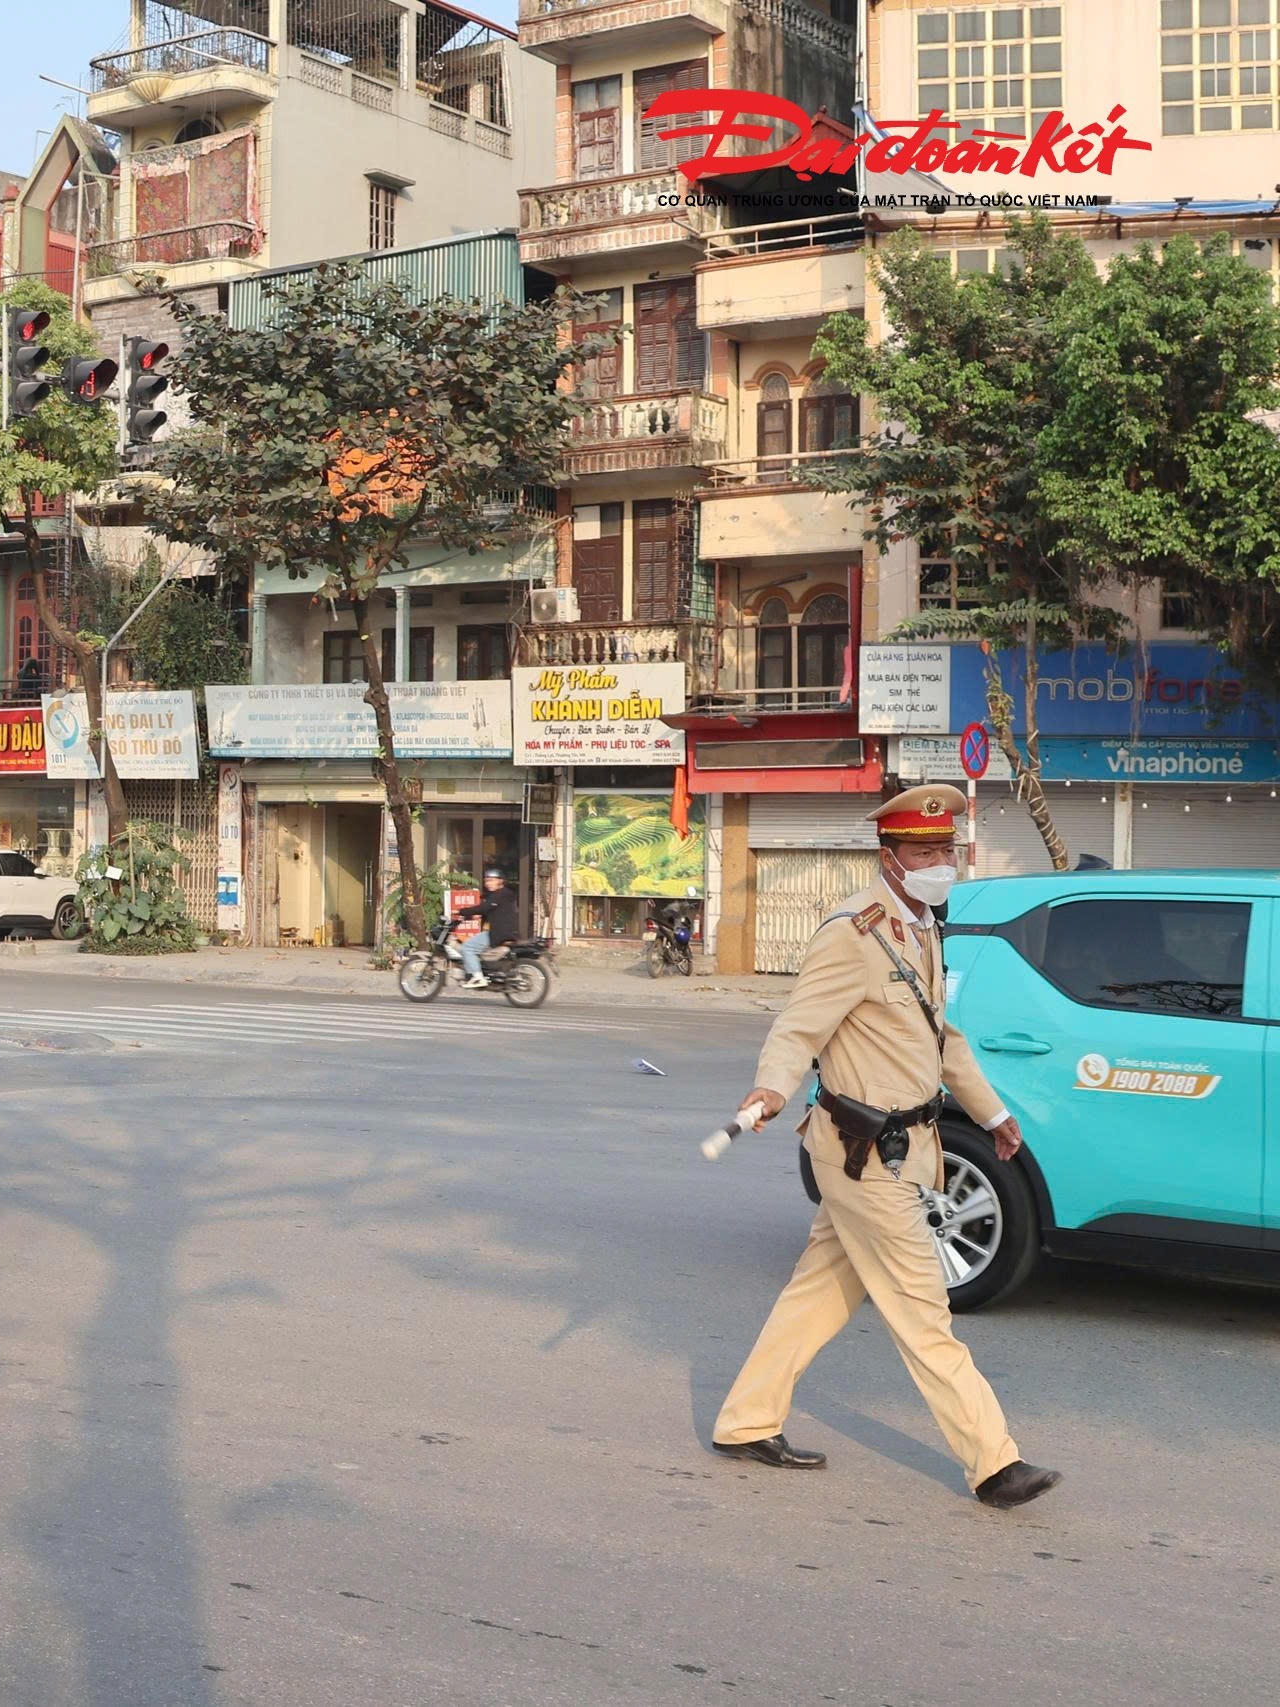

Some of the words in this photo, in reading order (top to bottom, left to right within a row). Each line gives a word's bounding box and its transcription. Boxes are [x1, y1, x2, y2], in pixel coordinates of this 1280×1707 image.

[529, 669, 564, 698] Mỹ
[567, 666, 619, 690] Phẩm
[867, 673, 883, 682] MUA
[1035, 668, 1243, 702] mobfone
[271, 690, 280, 699] TY
[281, 689, 301, 700] TNHH
[531, 694, 602, 721] KHÁNH
[608, 688, 663, 721] DIỄM
[889, 688, 902, 697] SIM
[130, 713, 154, 732] ĐẠI
[158, 709, 175, 729] LÝ
[11, 715, 44, 757] ĐẬU
[559, 737, 583, 750] PHẨM
[591, 739, 608, 752] PHỤ
[610, 739, 628, 751] LIỆU
[654, 739, 671, 749] SPA
[1106, 751, 1244, 777] vinaphone
[1110, 1070, 1152, 1091] 1900
[1151, 1073, 1199, 1094] 2088
